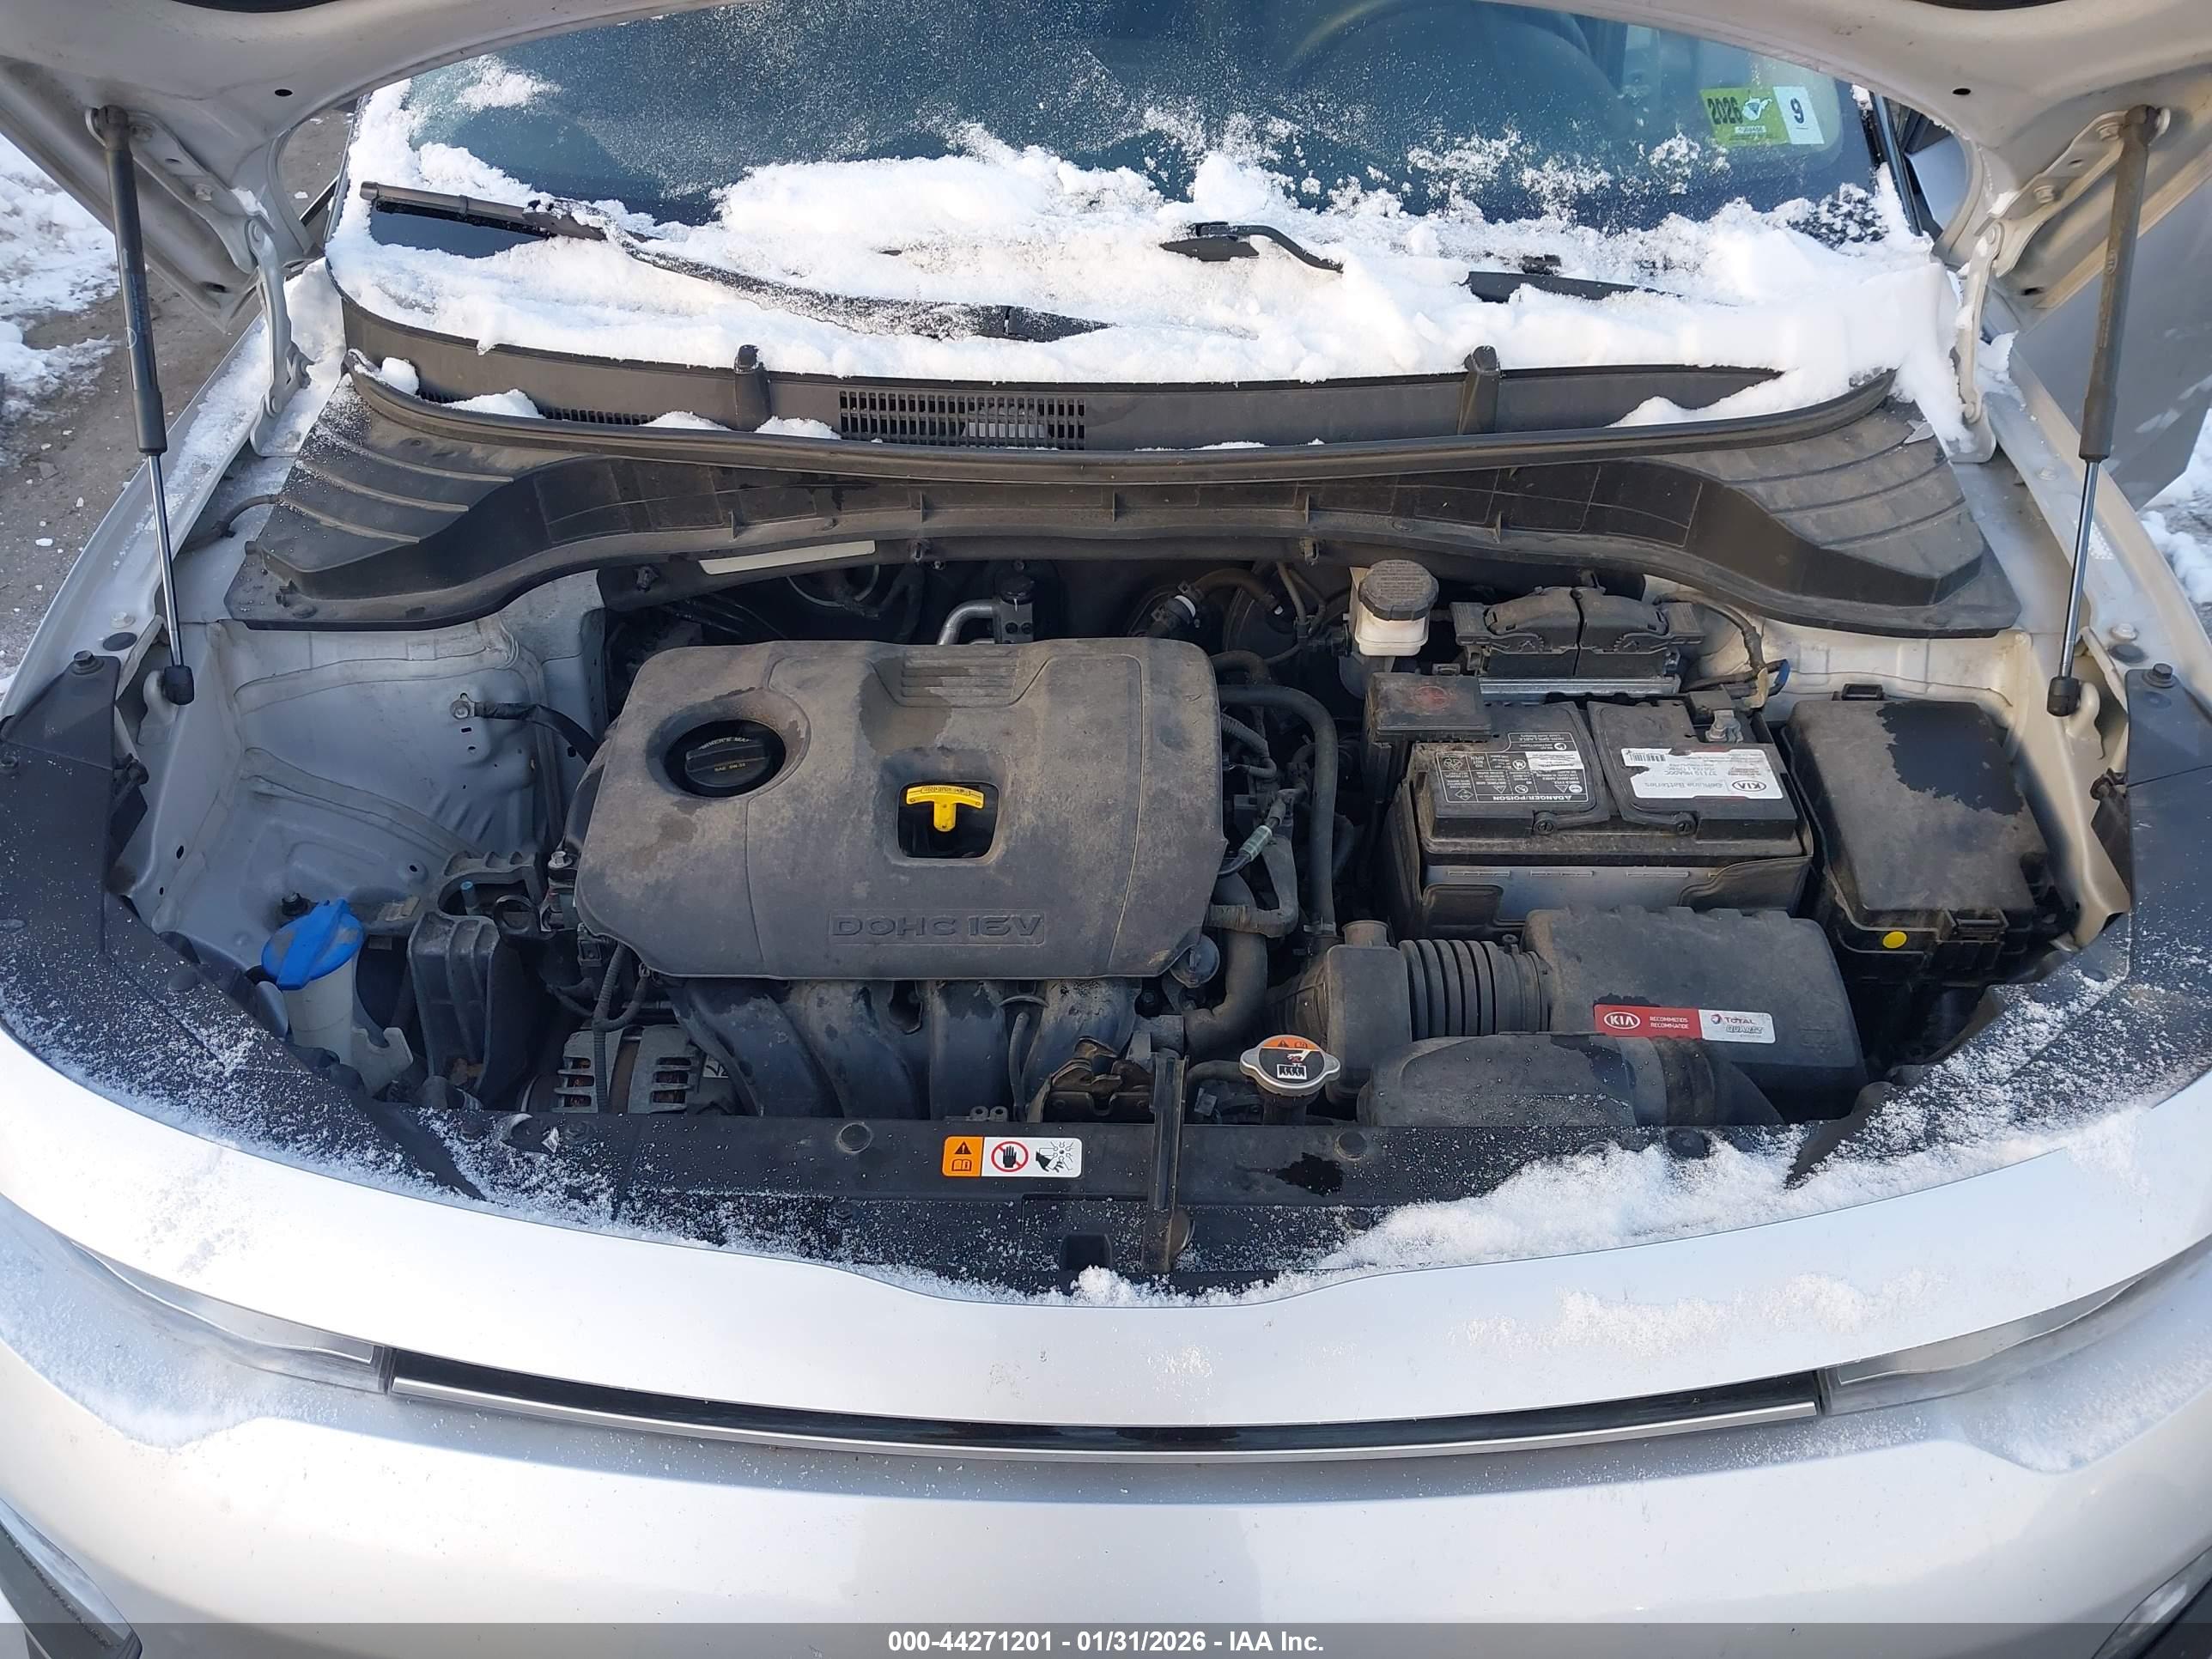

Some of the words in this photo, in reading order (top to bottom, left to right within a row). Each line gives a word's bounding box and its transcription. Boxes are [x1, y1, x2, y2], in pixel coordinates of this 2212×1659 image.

[1707, 96, 1744, 125] 2026
[1790, 98, 1804, 124] 9
[831, 916, 957, 936] DOHC
[968, 915, 1042, 937] 16V
